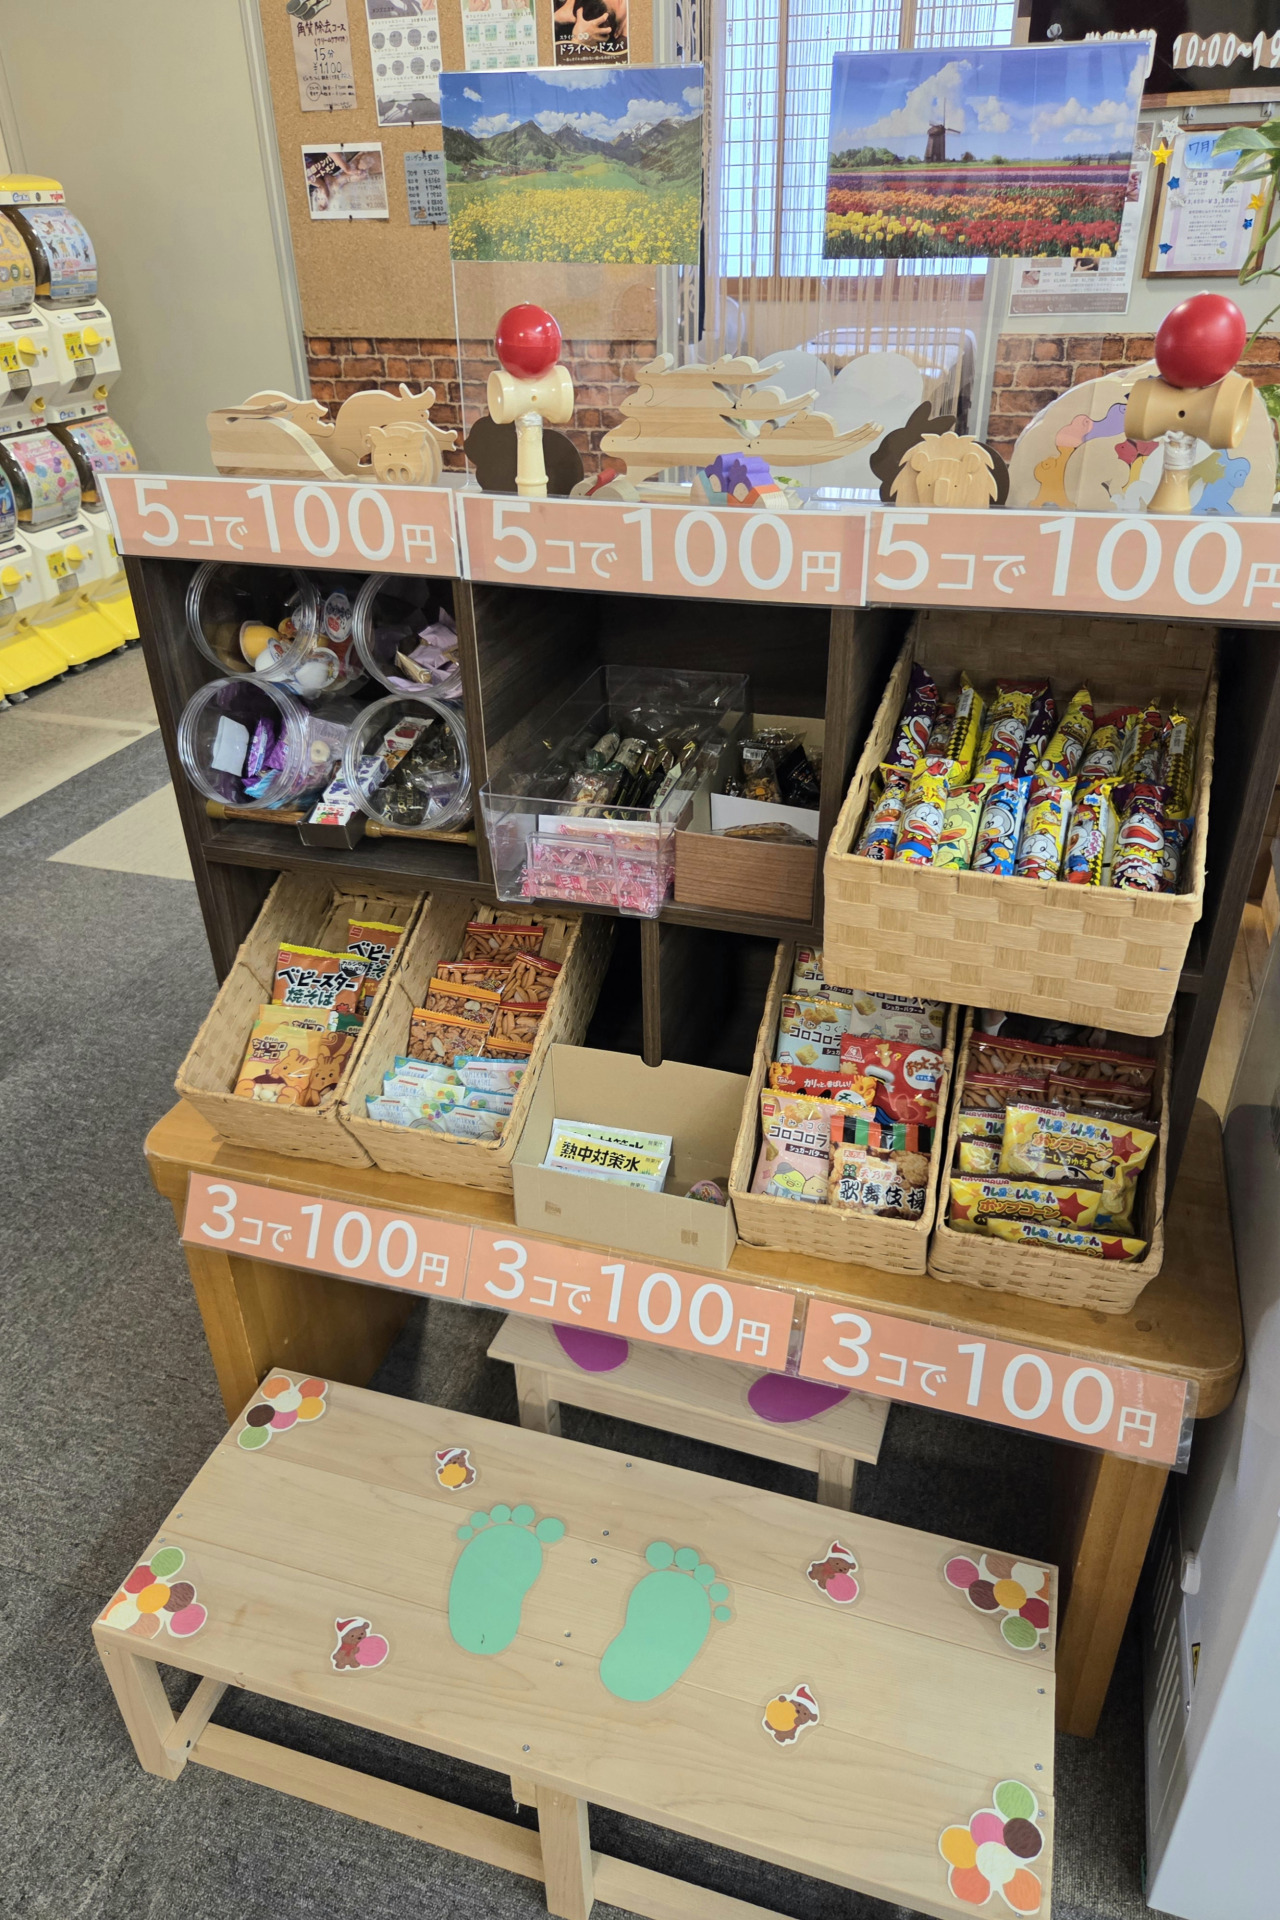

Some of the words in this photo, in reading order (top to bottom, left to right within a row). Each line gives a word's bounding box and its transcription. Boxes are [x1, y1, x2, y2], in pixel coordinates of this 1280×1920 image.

[297, 20, 346, 37] 角質除去コース
[314, 48, 334, 60] 15分
[560, 41, 624, 55] ドライヘッドスパ
[1188, 140, 1215, 155] 7月
[134, 479, 437, 564] 5コで100円
[492, 500, 842, 592] 5コで100円
[874, 513, 1280, 608] 5コで100円
[348, 941, 397, 961] ベビー
[278, 968, 356, 991] ベビースター
[285, 987, 335, 1006] 焼そば
[906, 1056, 944, 1077] おっとっと
[1038, 1116, 1111, 1141] クレヨンしんちゃん
[560, 1141, 641, 1172] 熱中対策水
[1032, 1132, 1113, 1159] ポップコーン
[860, 1168, 902, 1182] 天乃屋の
[840, 1180, 926, 1210] 歌舞伎揚
[982, 1186, 1056, 1204] クレヨンしんちゃん
[978, 1199, 1060, 1219] ポップコーン
[200, 1184, 450, 1287] 3コで100円
[1022, 1225, 1100, 1247] クレヨンしんちゃん
[484, 1240, 770, 1356] 3コで100円
[822, 1313, 1157, 1448] 3コで100円
